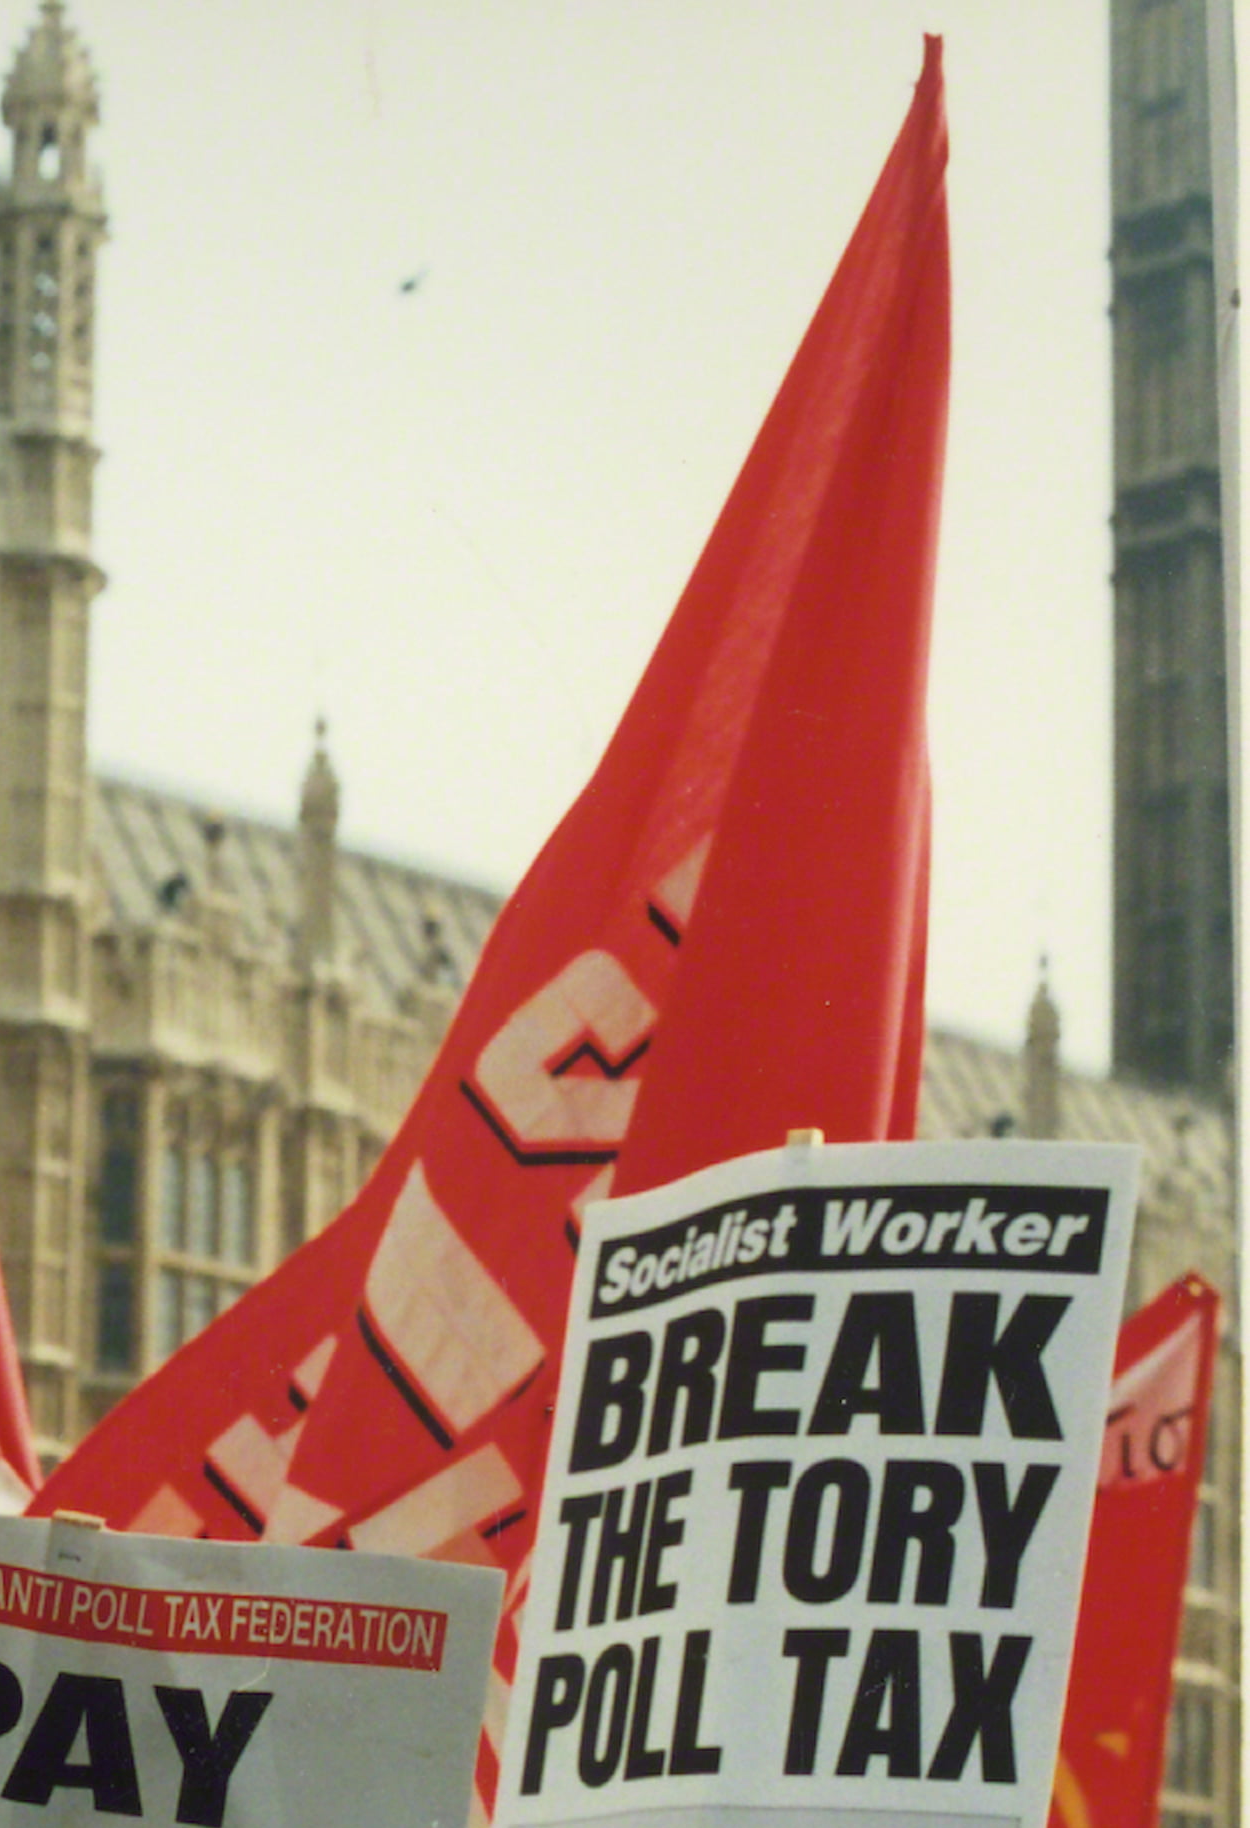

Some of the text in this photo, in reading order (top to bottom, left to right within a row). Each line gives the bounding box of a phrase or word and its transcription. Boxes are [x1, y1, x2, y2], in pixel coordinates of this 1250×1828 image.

[599, 1198, 1090, 1303] Socialist Worker
[568, 1291, 1074, 1475] BREAK
[69, 1585, 154, 1636] POLL
[165, 1595, 222, 1640] TAX
[230, 1599, 437, 1657] FEDERATION
[554, 1458, 1062, 1632] THE TORY
[520, 1628, 1034, 1795] POLL TAX
